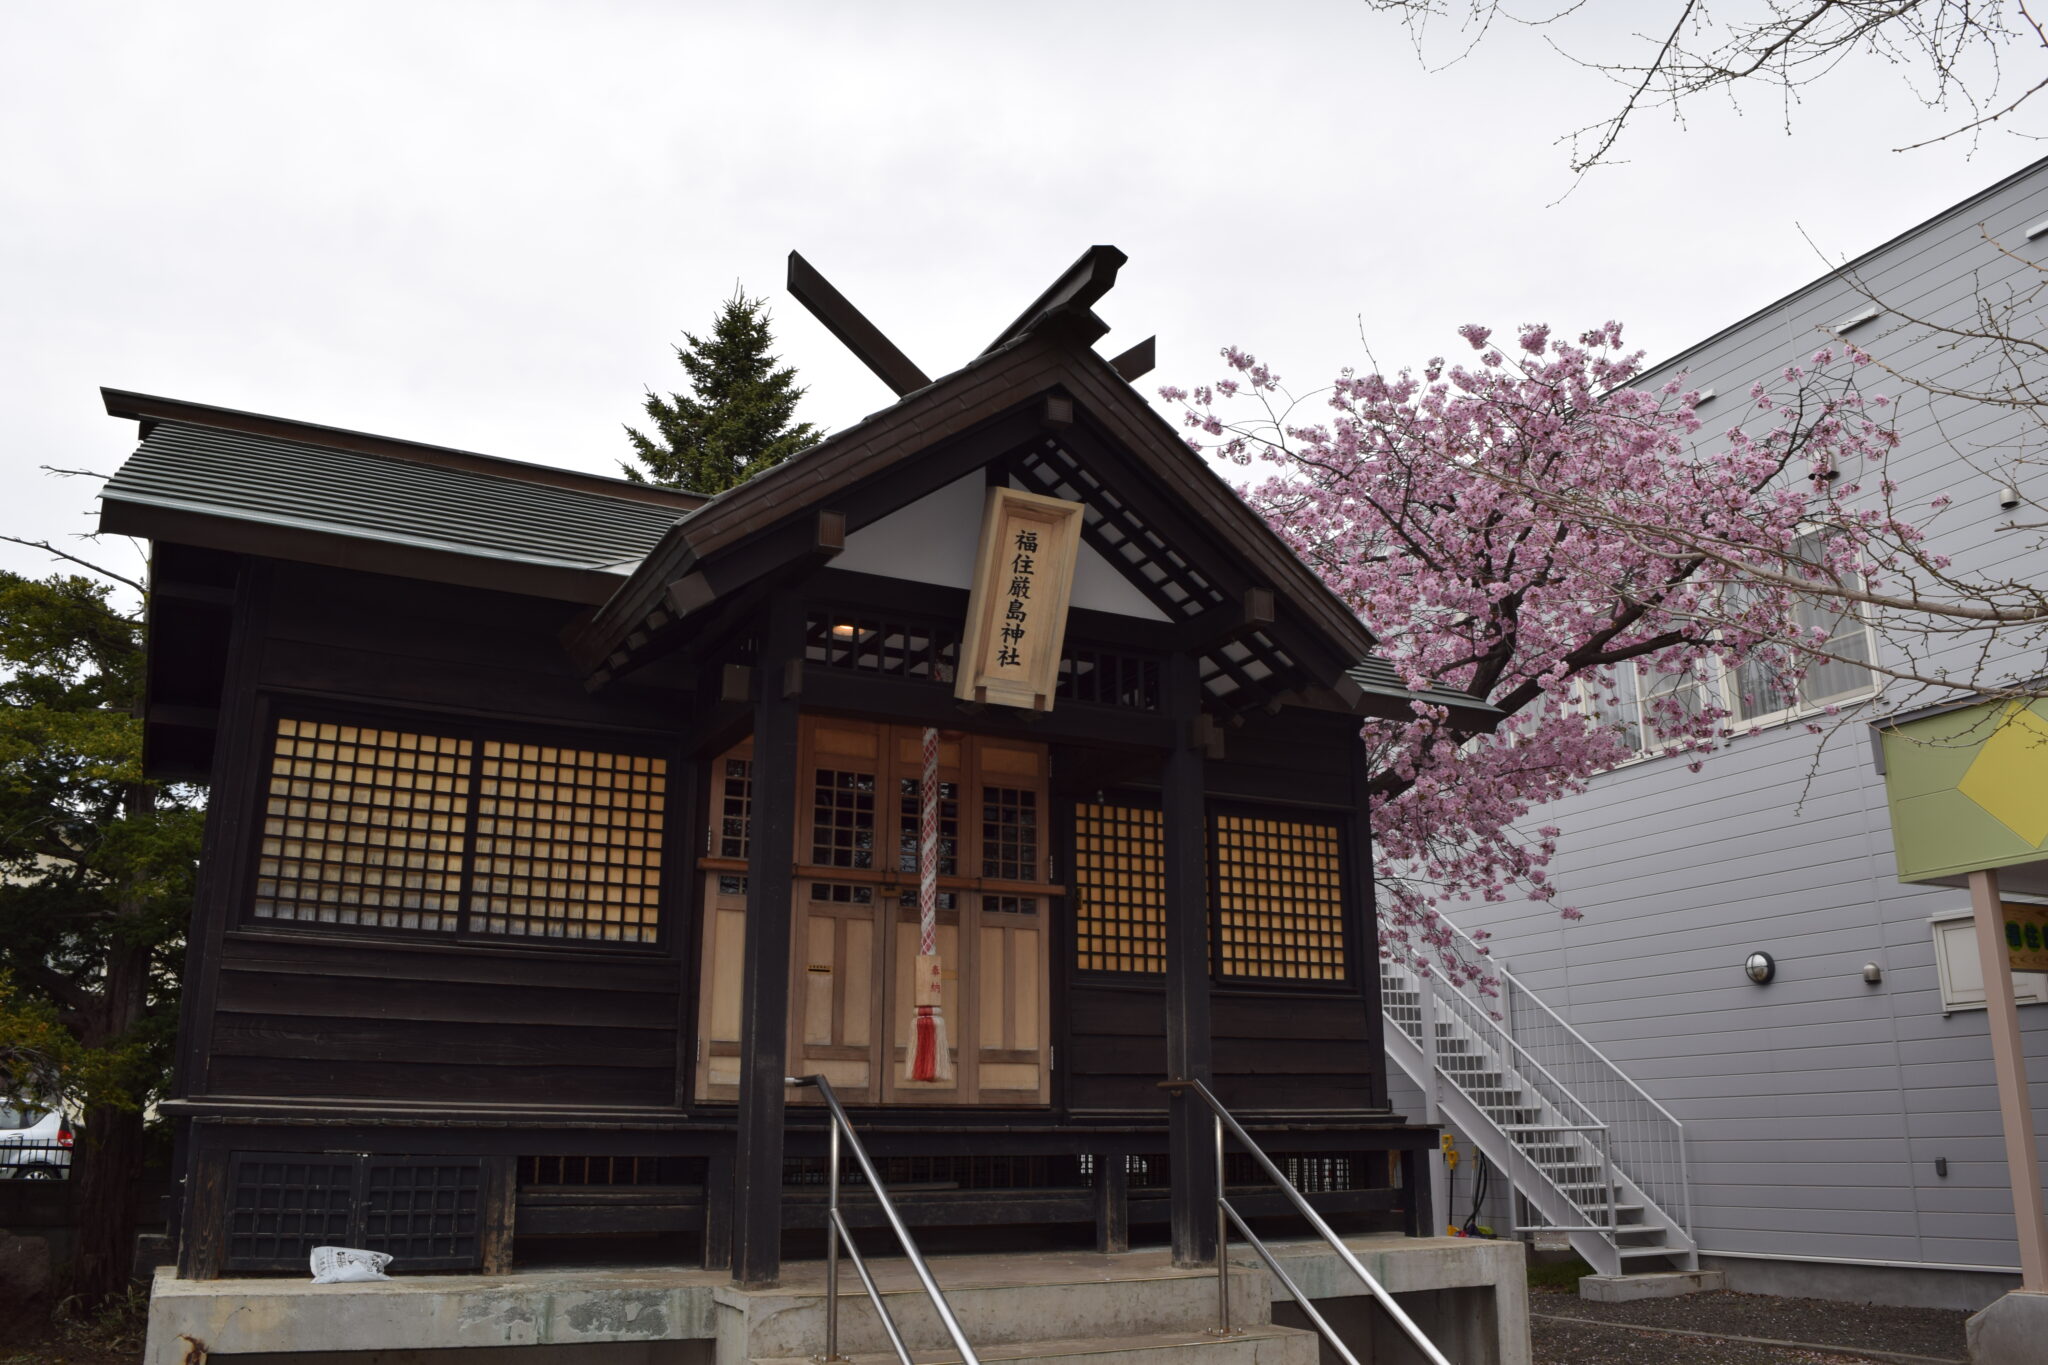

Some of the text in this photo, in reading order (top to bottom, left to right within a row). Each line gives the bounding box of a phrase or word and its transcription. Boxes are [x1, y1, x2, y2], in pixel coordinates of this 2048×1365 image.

[996, 529, 1038, 668] 福住厳島神社
